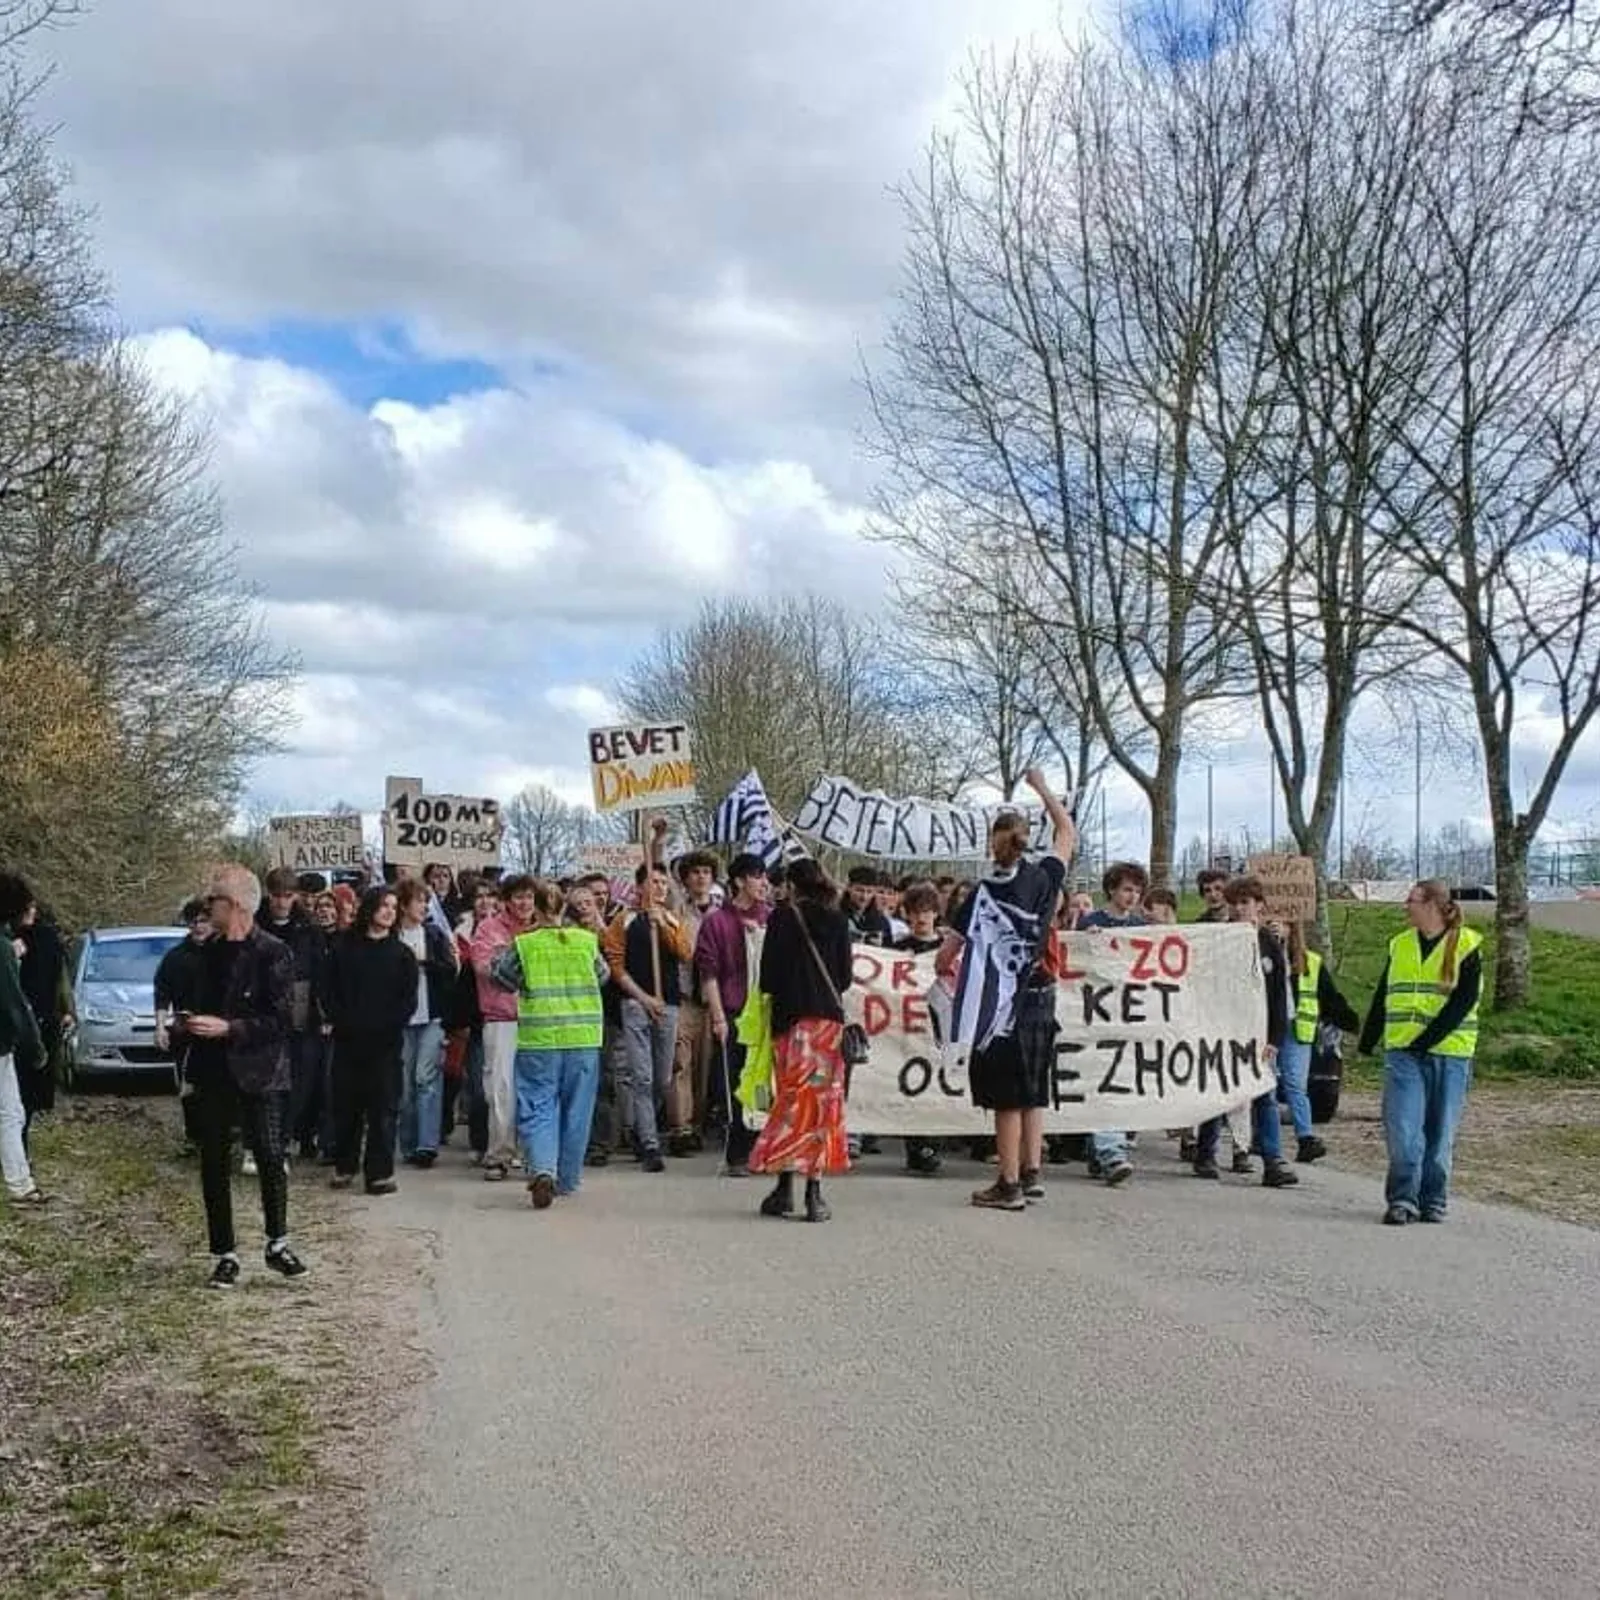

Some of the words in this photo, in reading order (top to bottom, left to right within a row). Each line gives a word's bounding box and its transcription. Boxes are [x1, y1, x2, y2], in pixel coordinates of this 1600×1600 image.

[590, 725, 685, 764] BEVET
[391, 791, 451, 824] 100
[793, 775, 916, 855] BETEK
[397, 822, 447, 847] 200
[1082, 981, 1180, 1027] KET
